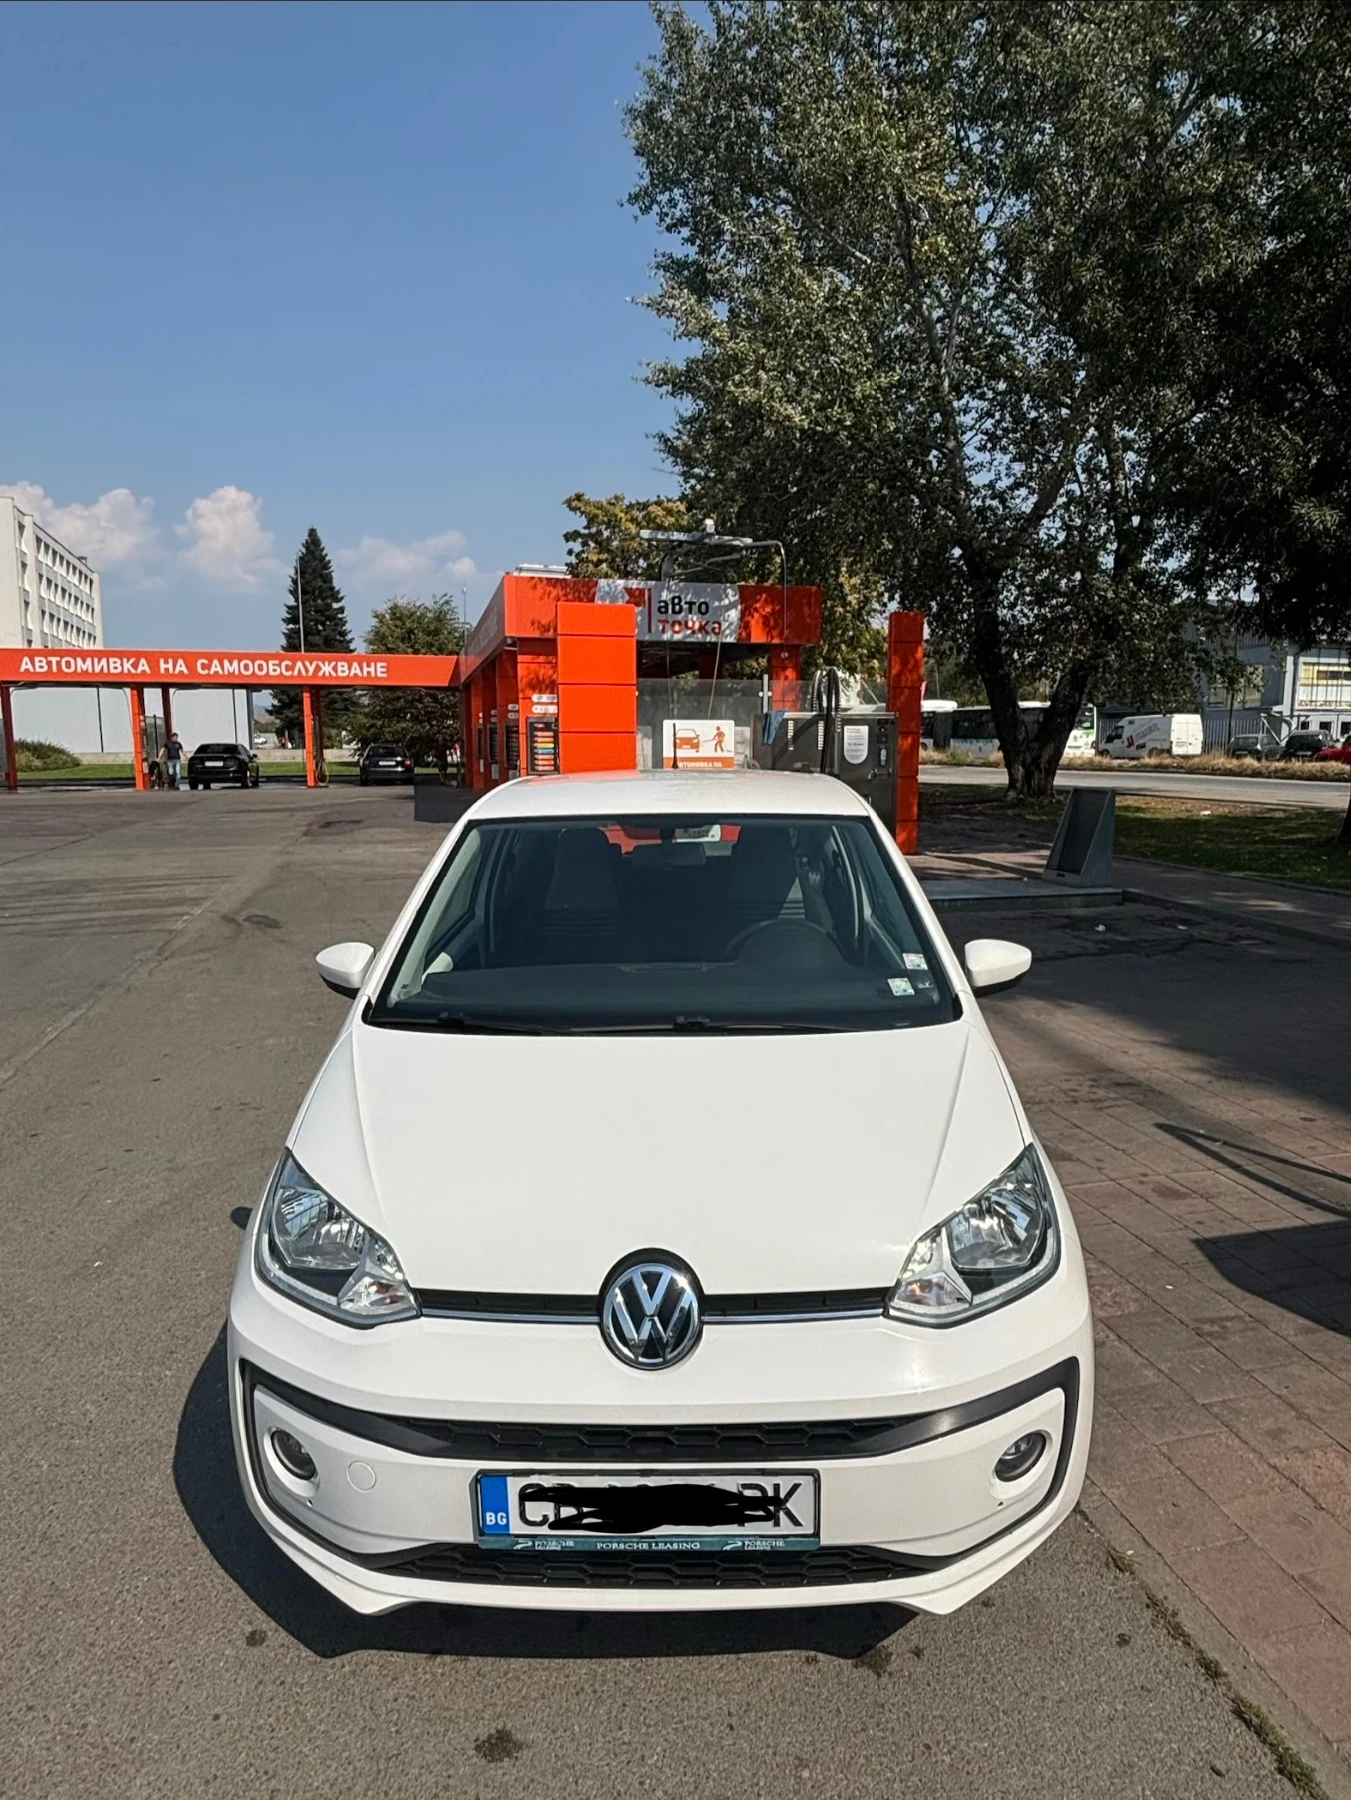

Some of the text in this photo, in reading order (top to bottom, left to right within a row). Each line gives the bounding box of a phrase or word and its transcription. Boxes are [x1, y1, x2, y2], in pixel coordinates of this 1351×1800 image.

[657, 619, 722, 636] точка
[19, 656, 388, 678] АВТОМИВКА НА САМООБСЛУЖВАНЕ
[485, 1511, 507, 1525] BG
[596, 1542, 701, 1550] PORSCHE LEASING
